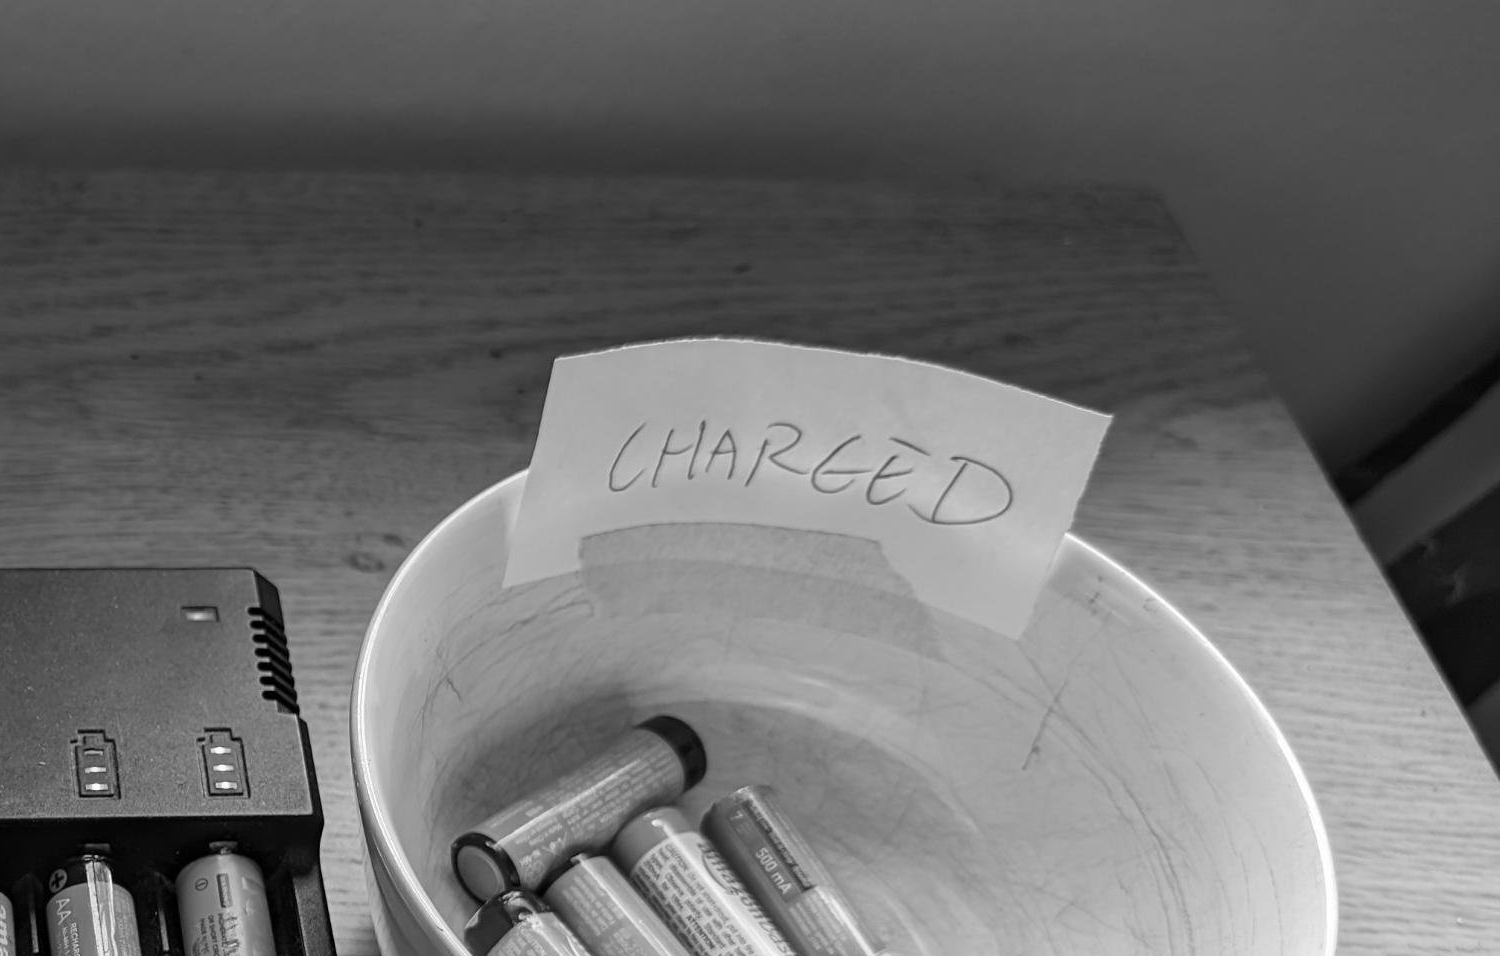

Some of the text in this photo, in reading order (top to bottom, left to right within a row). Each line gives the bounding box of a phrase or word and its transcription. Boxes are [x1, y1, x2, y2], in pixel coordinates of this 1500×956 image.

[608, 420, 1014, 526] CHARGED
[755, 847, 777, 871] 500
[771, 871, 791, 892] mA
[55, 897, 73, 925] AA
[208, 924, 217, 943] SHORT
